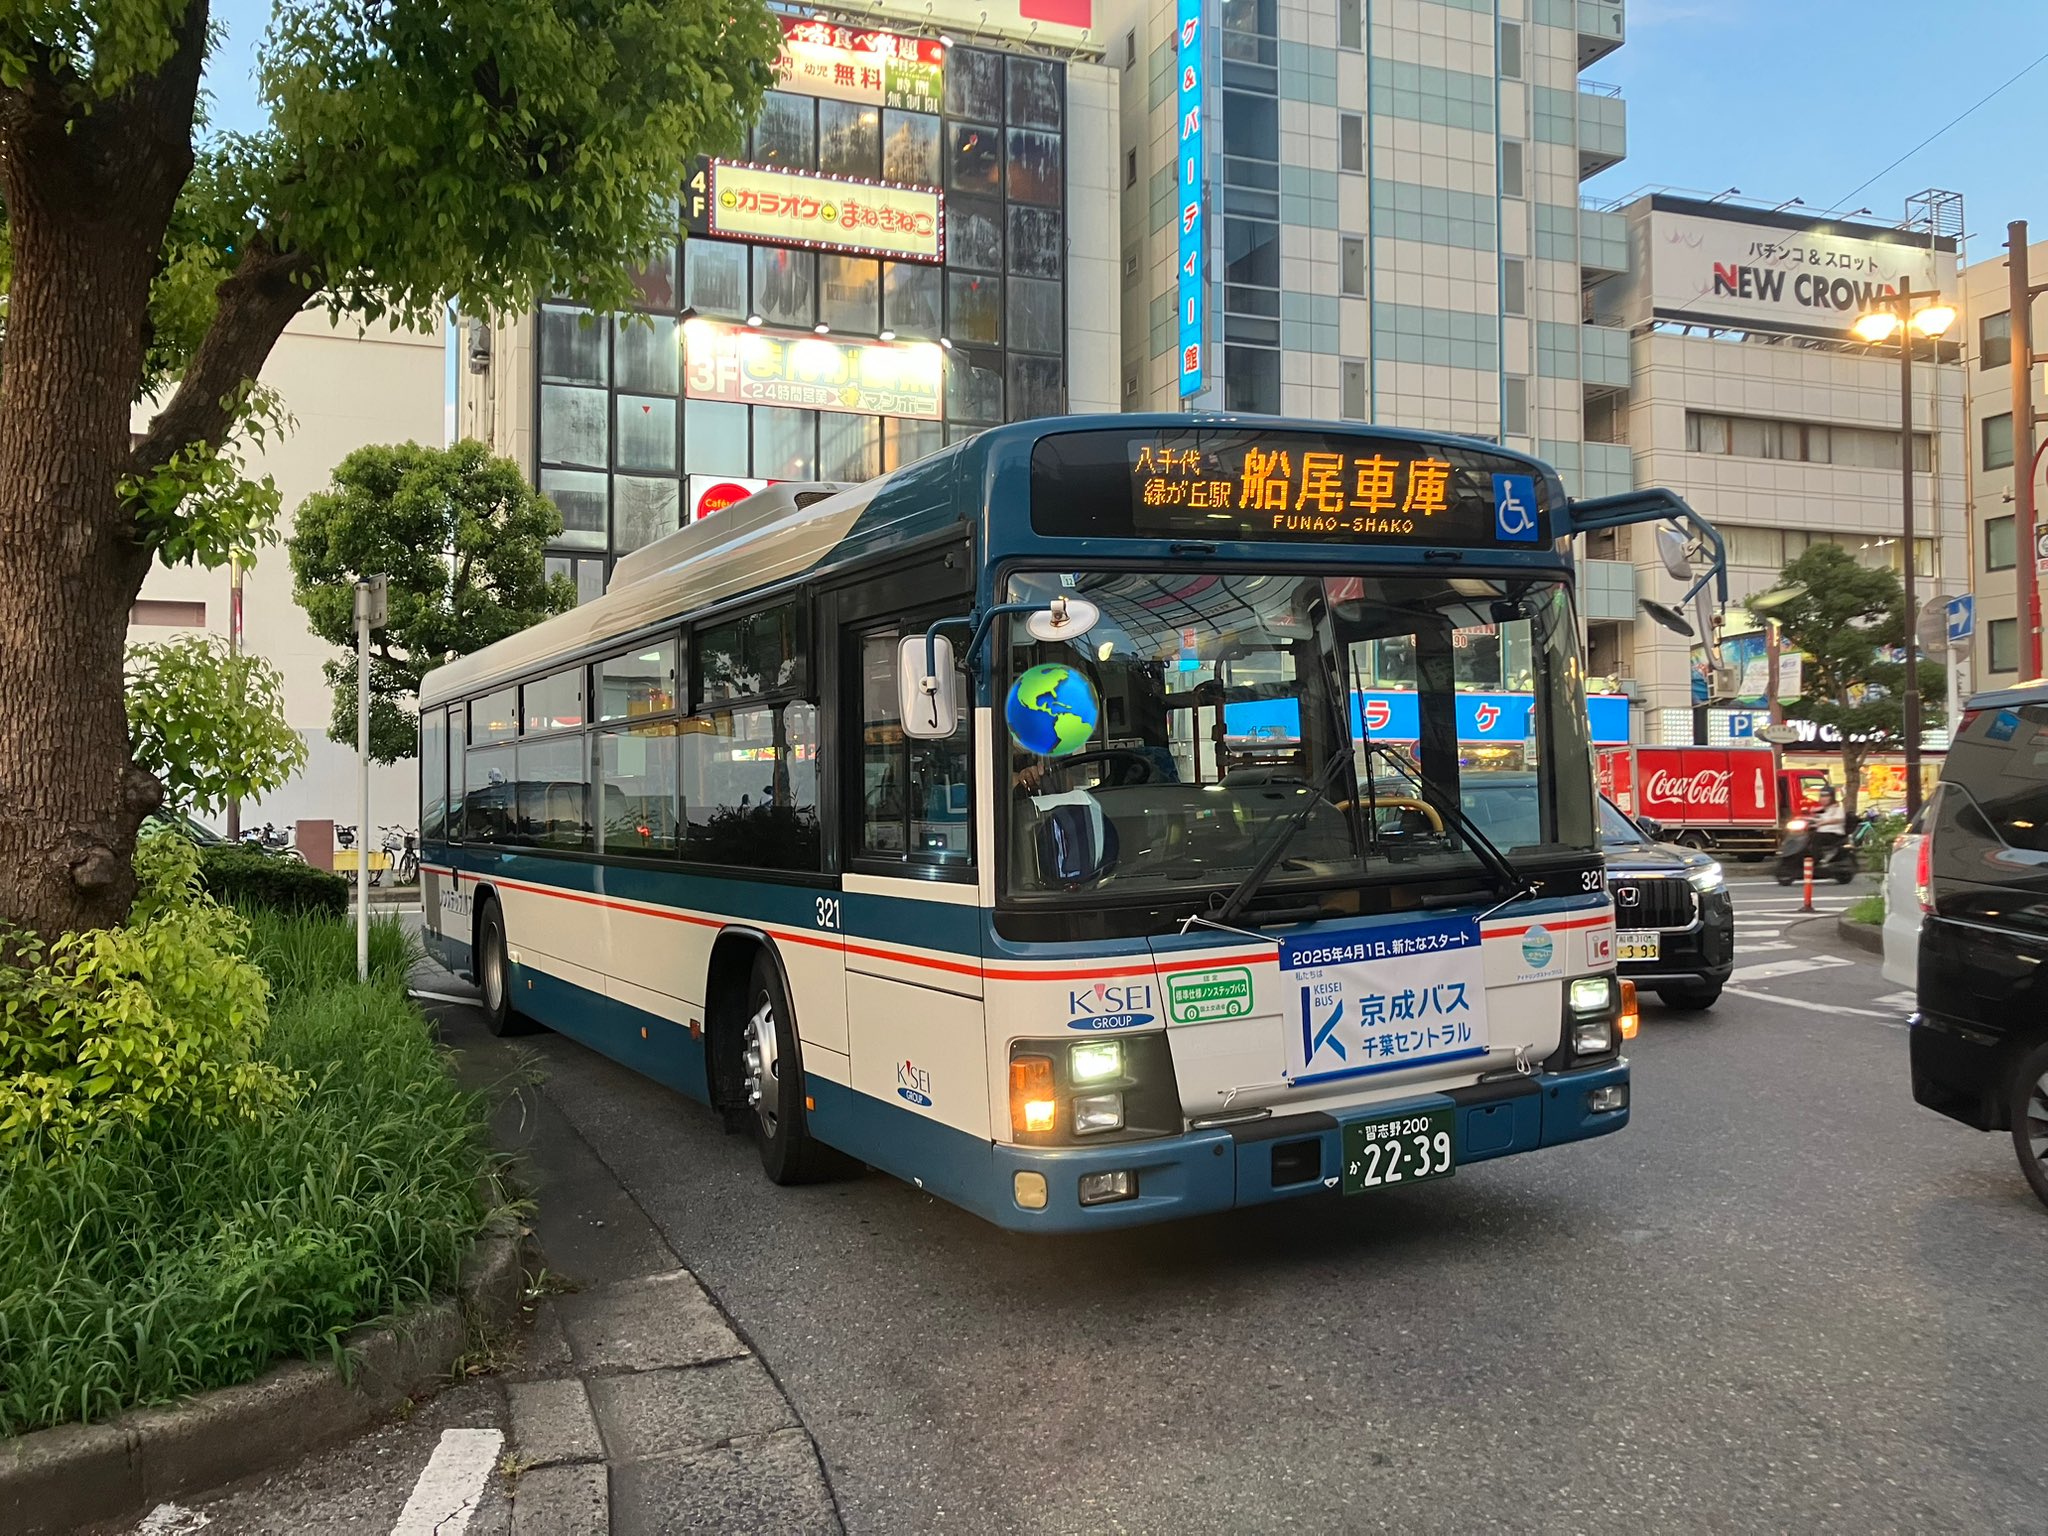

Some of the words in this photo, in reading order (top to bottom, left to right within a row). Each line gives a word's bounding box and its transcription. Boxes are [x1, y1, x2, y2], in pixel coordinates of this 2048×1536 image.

[834, 63, 882, 90] 無料
[737, 190, 821, 221] カラオケ
[840, 199, 934, 237] まねきねこ
[1714, 262, 1786, 302] NEW
[689, 350, 739, 394] 3F
[752, 382, 829, 406] 24時間営業
[1135, 447, 1201, 475] 八千代
[1144, 479, 1231, 508] 緑が丘駅
[1239, 447, 1451, 516] 船尾車庫
[1273, 514, 1414, 533] FUNAO-SHAKO
[1365, 701, 1391, 730] ラ
[1475, 702, 1500, 732] ケ
[1646, 769, 1734, 805] Coca-Cola
[1582, 870, 1604, 891] 321
[816, 896, 841, 929] 321
[1292, 930, 1470, 966] 2025年4月1日、新たなスタート
[1296, 969, 1323, 981] 私たちは
[1313, 982, 1342, 995] KEISEI
[1315, 995, 1334, 1008] BUS
[1359, 982, 1470, 1028] 京成バス
[1092, 1016, 1132, 1029] GROUP
[1362, 1021, 1471, 1059] 千葉セントラル
[1363, 1131, 1451, 1187] 22-39
